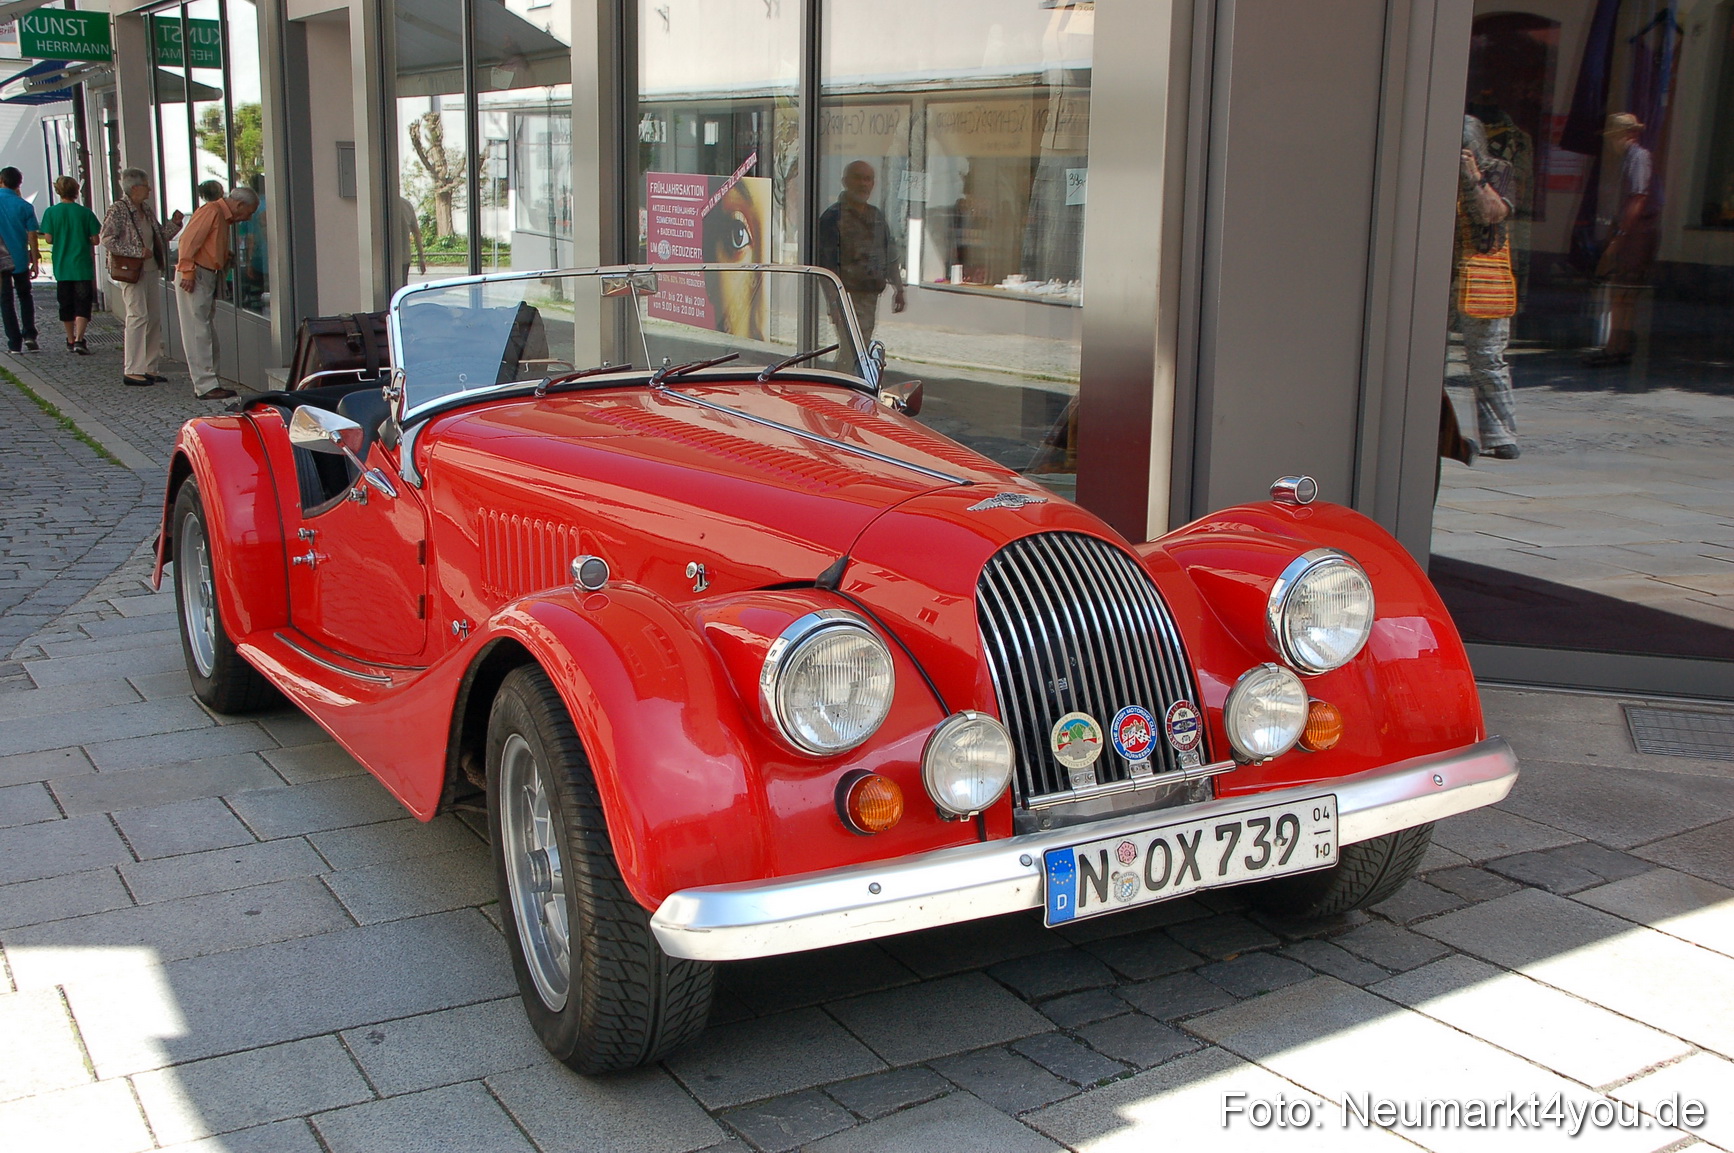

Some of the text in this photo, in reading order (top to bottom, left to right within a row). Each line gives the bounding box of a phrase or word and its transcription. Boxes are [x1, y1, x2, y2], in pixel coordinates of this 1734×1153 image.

[22, 16, 88, 36] KUNST
[37, 40, 109, 54] HERRMANN
[650, 181, 704, 196] FRÜHJAHRSAKTION
[652, 205, 671, 213] AKTUELLE
[671, 244, 702, 260] REDUZIERT!
[694, 296, 705, 307] 2010
[1126, 707, 1150, 721] MOTORING
[1313, 806, 1330, 822] 04
[1315, 842, 1330, 858] 10
[1079, 850, 1109, 907] N
[1144, 830, 1202, 891] OX
[1215, 813, 1300, 876] 739
[1056, 894, 1067, 910] D
